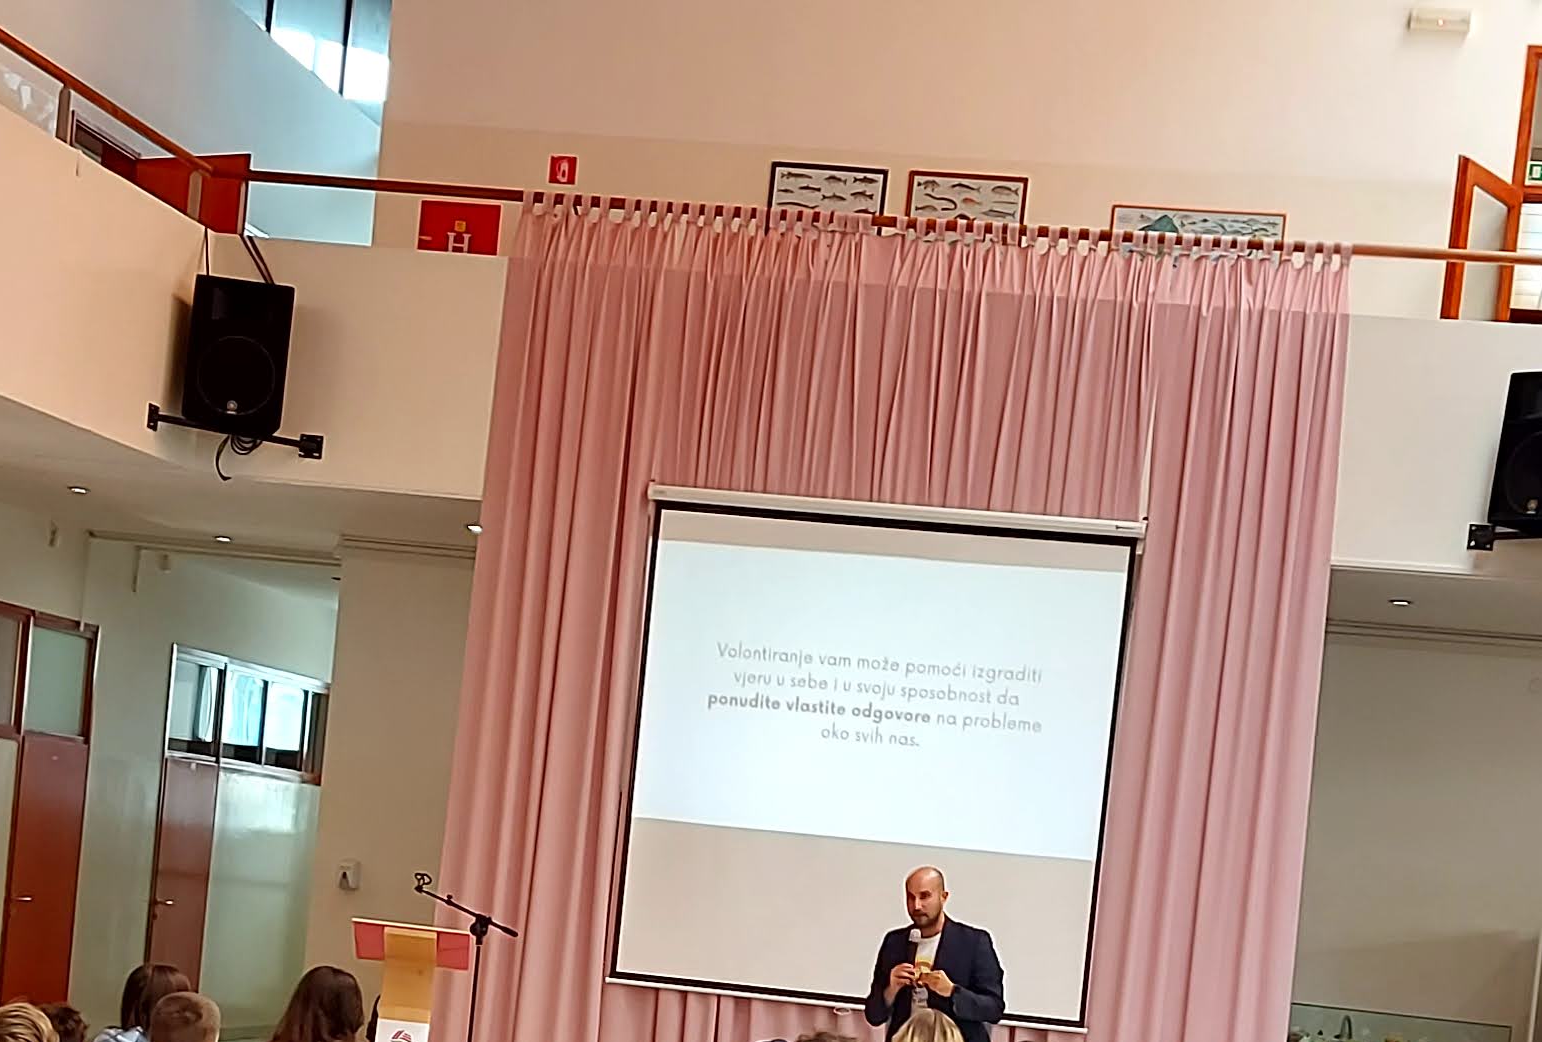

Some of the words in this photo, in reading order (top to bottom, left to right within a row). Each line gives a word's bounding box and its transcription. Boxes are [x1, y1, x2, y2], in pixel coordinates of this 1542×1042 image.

[716, 641, 813, 669] Volontiranje
[819, 653, 852, 668] vam
[857, 656, 900, 672] može
[905, 661, 967, 678] pomoći
[972, 664, 1043, 684] izgraditi
[734, 671, 772, 688] vjeru
[776, 674, 786, 687] u
[790, 672, 829, 692] sebe
[843, 680, 852, 692] u
[857, 682, 896, 701] svoju
[900, 684, 992, 704] sposobnost
[996, 688, 1020, 706] da
[707, 692, 781, 711] ponudite
[786, 696, 846, 716] vlastite
[851, 701, 931, 724] odgovore
[936, 713, 957, 727] na
[962, 712, 1043, 733] probleme
[820, 722, 850, 741] oko
[855, 726, 884, 745] svih
